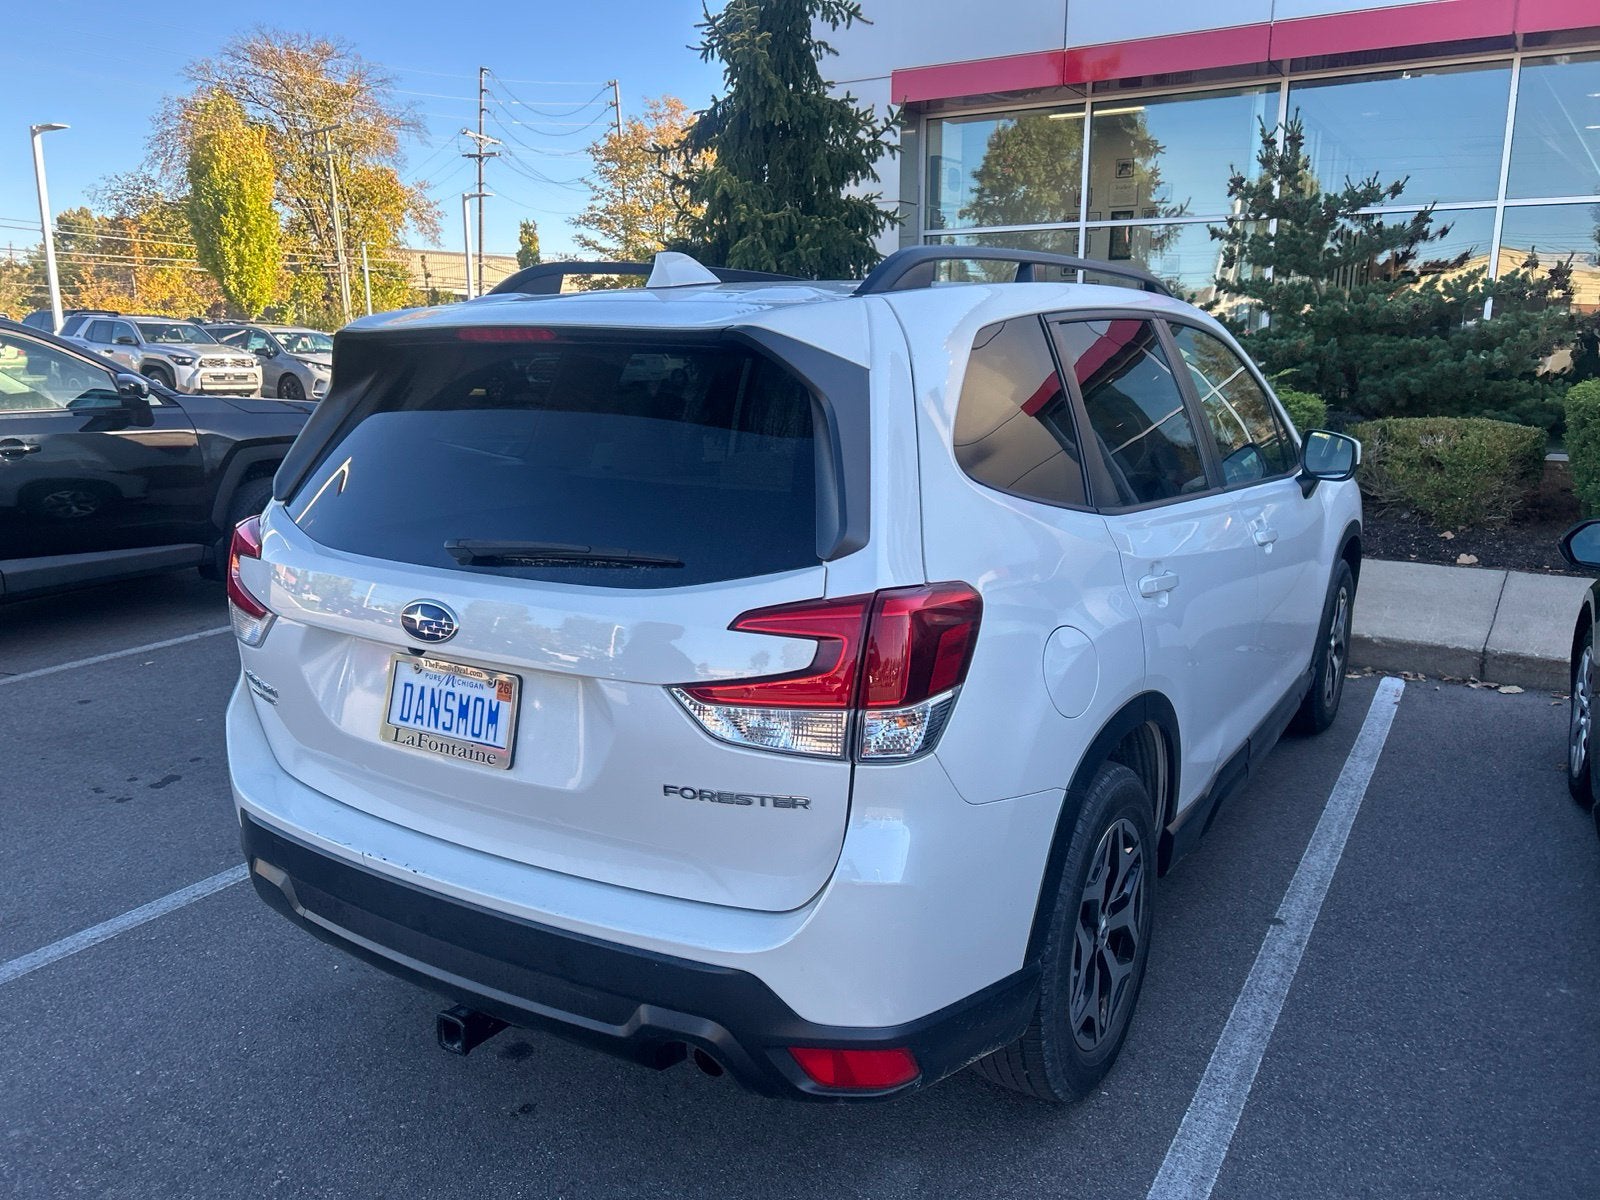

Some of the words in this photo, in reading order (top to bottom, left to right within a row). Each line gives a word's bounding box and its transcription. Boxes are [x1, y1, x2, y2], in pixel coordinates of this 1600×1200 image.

[425, 673, 441, 682] PURE
[437, 673, 484, 690] MICHIGAN
[497, 681, 509, 694] 26
[399, 682, 501, 742] DANSMOM
[392, 727, 497, 765] LaFontaine
[662, 784, 812, 810] FORESTER
